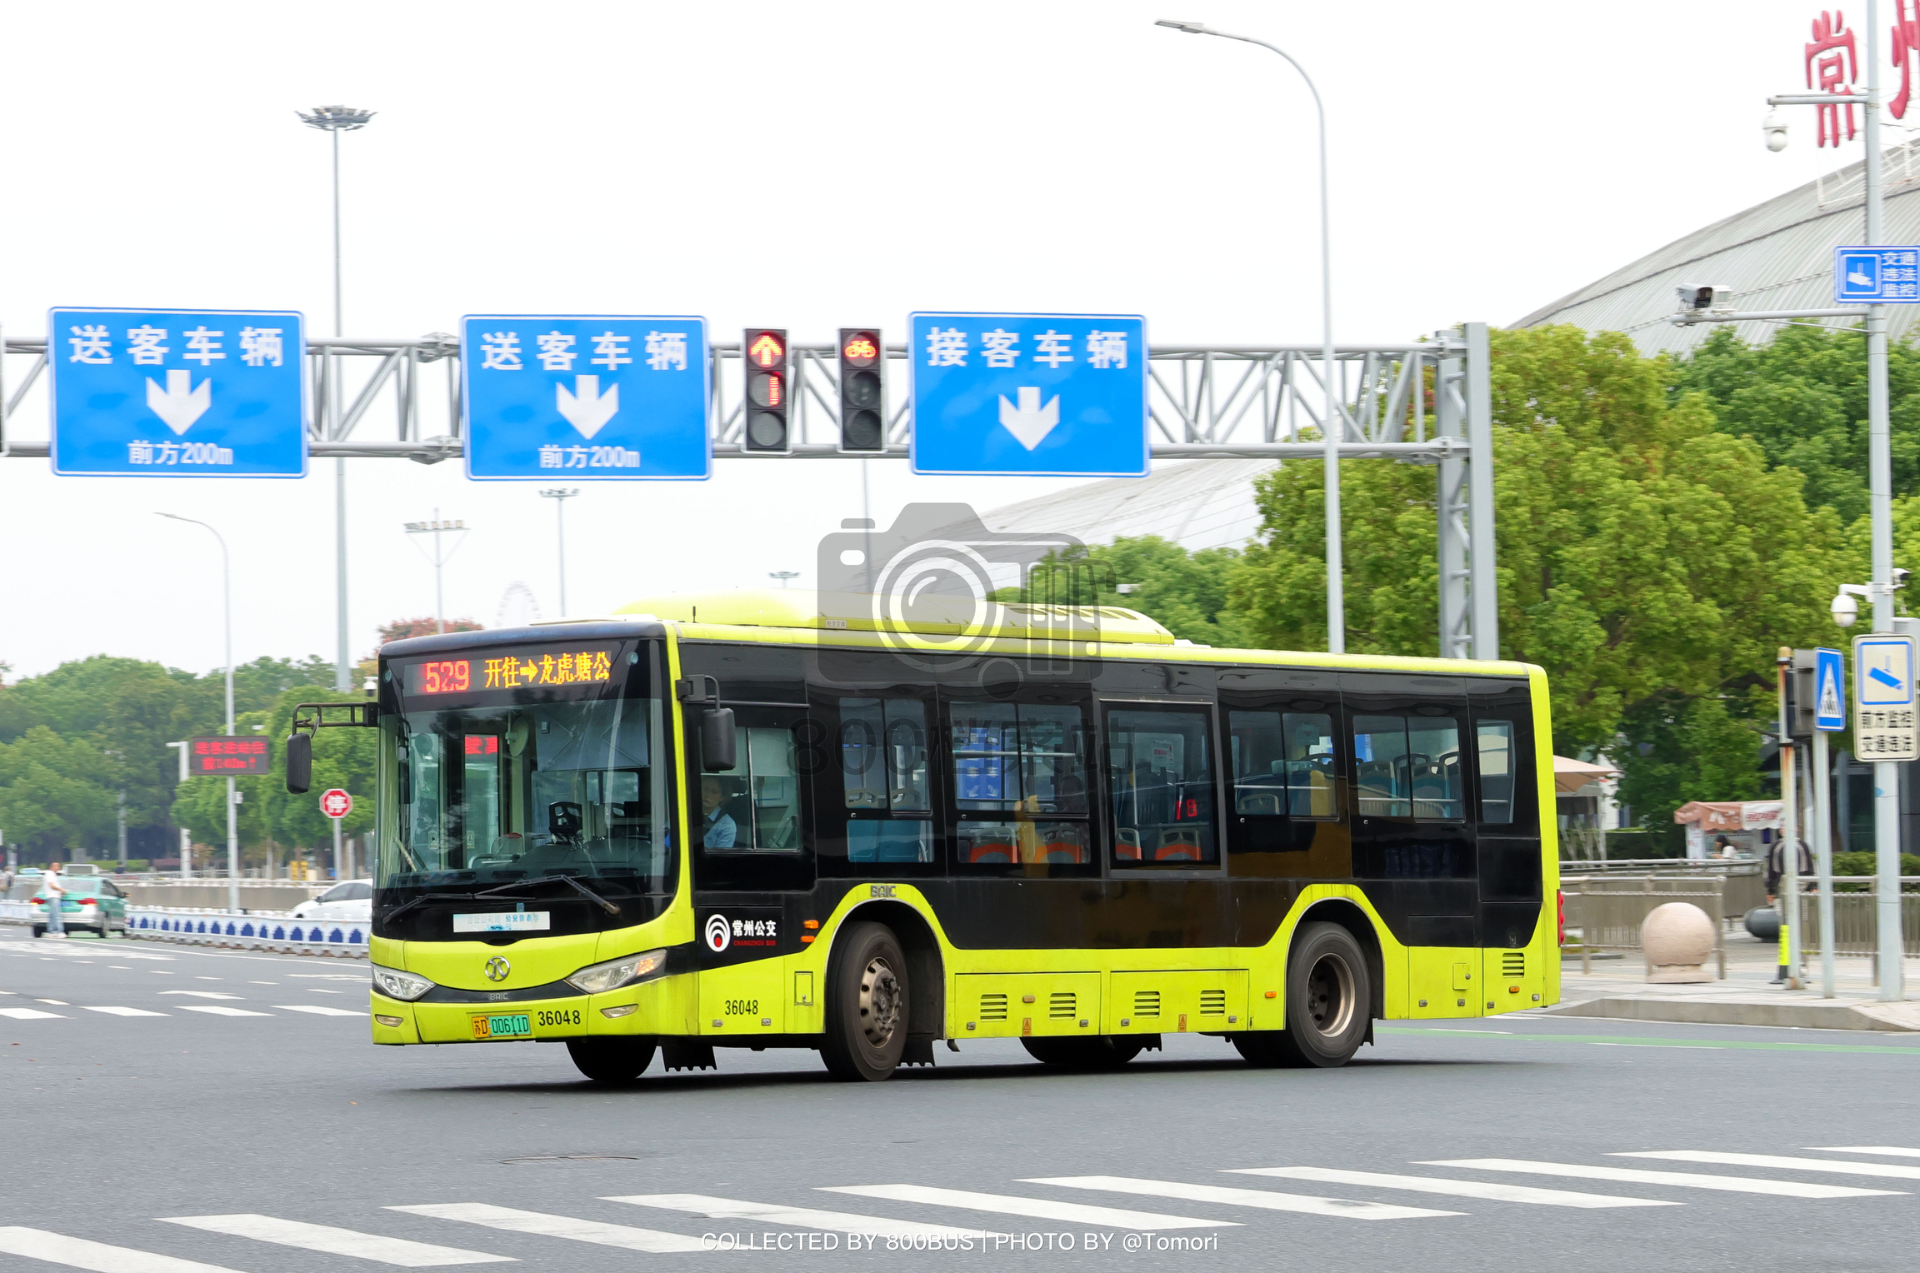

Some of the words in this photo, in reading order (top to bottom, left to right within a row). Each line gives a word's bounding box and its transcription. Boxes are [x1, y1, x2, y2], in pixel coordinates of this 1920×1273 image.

[68, 325, 284, 368] 送客车辆
[480, 330, 689, 371] 送客车辆
[926, 326, 1128, 370] 接客车辆
[128, 440, 234, 466] 前方200m
[538, 443, 641, 469] 前方200m
[424, 659, 470, 693] 529
[484, 656, 521, 688] 开往
[538, 652, 611, 685] 龙虎塘公
[870, 885, 897, 897] BAIC
[732, 919, 777, 937] 常州公交
[537, 1010, 581, 1027] 36048
[725, 1000, 759, 1015] 36048
